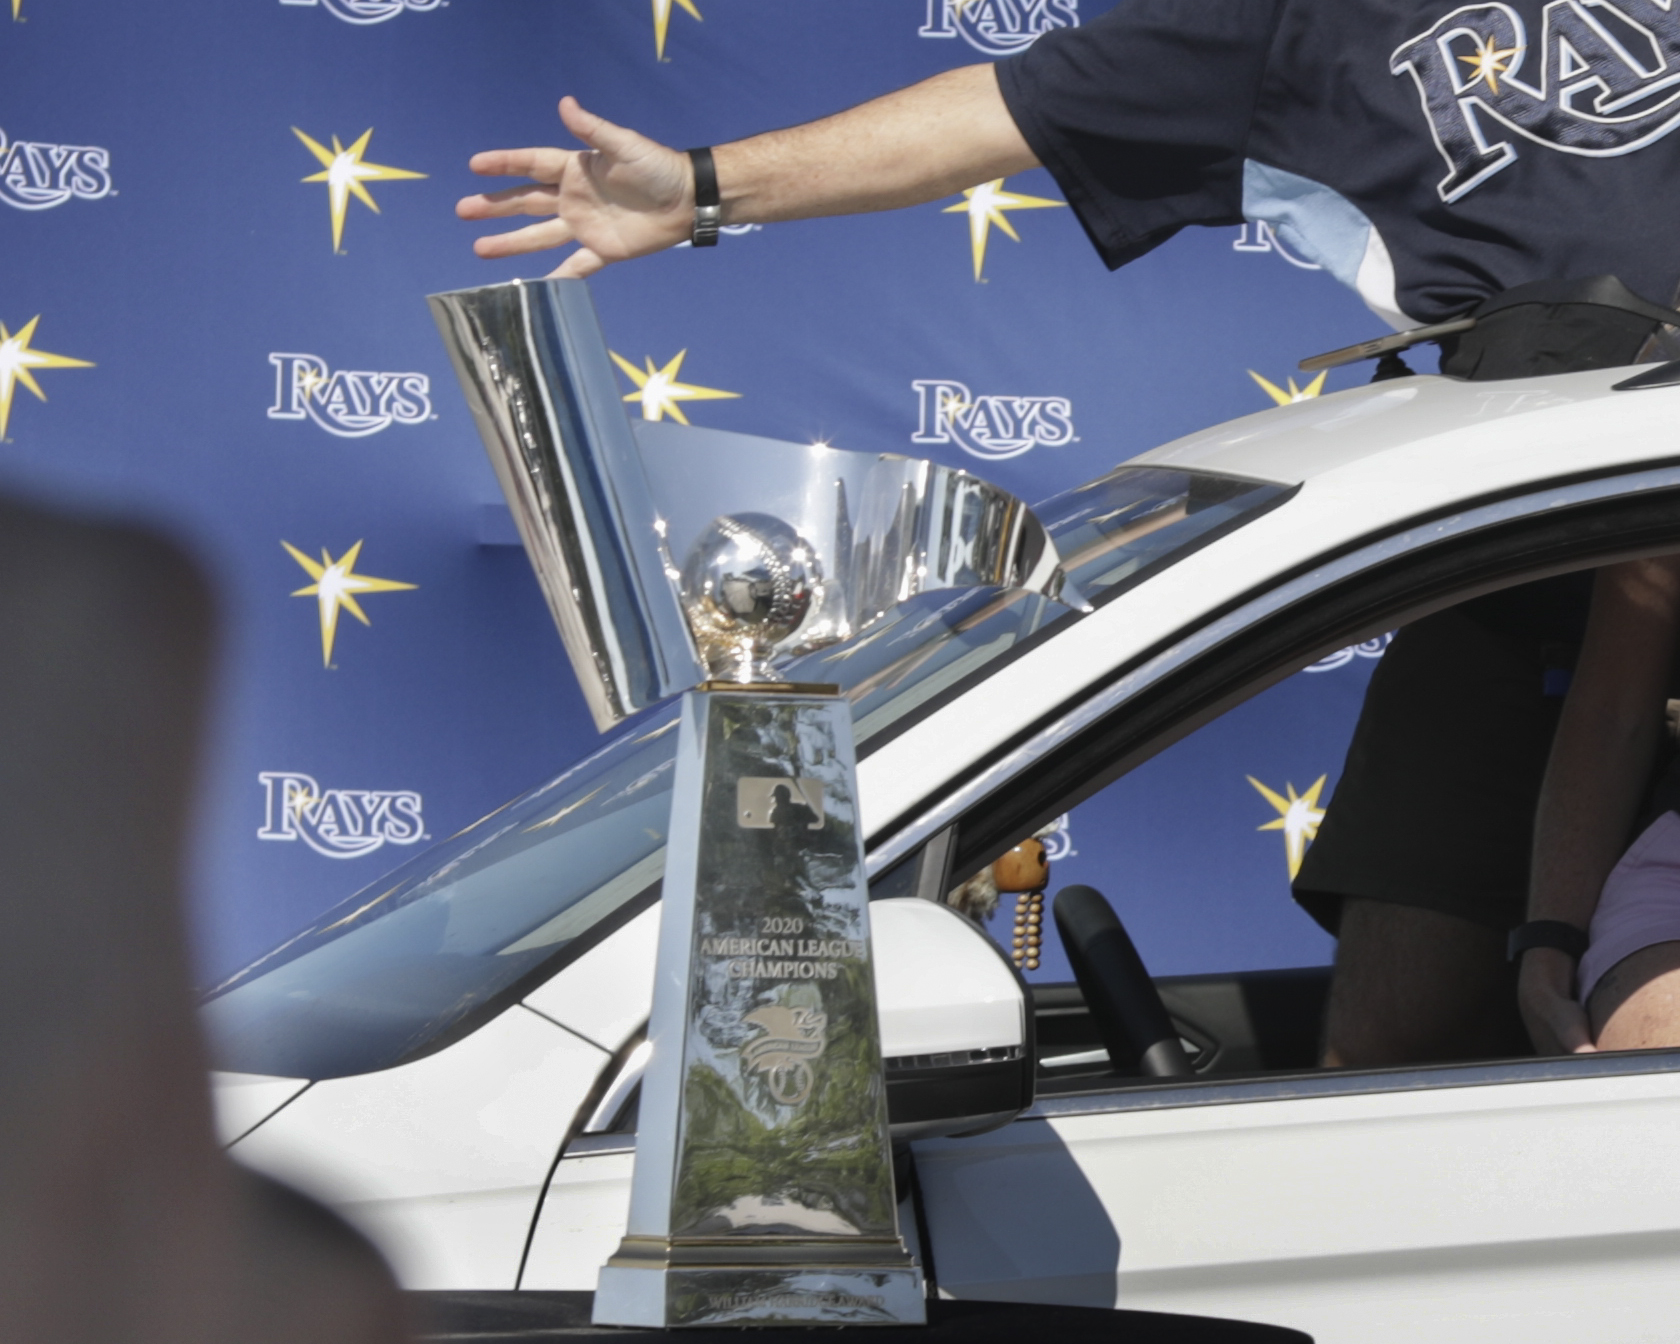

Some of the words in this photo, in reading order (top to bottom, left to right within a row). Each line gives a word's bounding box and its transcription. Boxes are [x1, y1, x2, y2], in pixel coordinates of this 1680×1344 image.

[269, 351, 431, 437] RAYS
[912, 380, 1073, 459] RAYS
[258, 771, 424, 859] RAYS
[699, 938, 795, 957] AMERICAN
[796, 939, 864, 958] LEAGUE
[761, 917, 804, 933] 2020
[728, 960, 839, 980] CHAMPIONS
